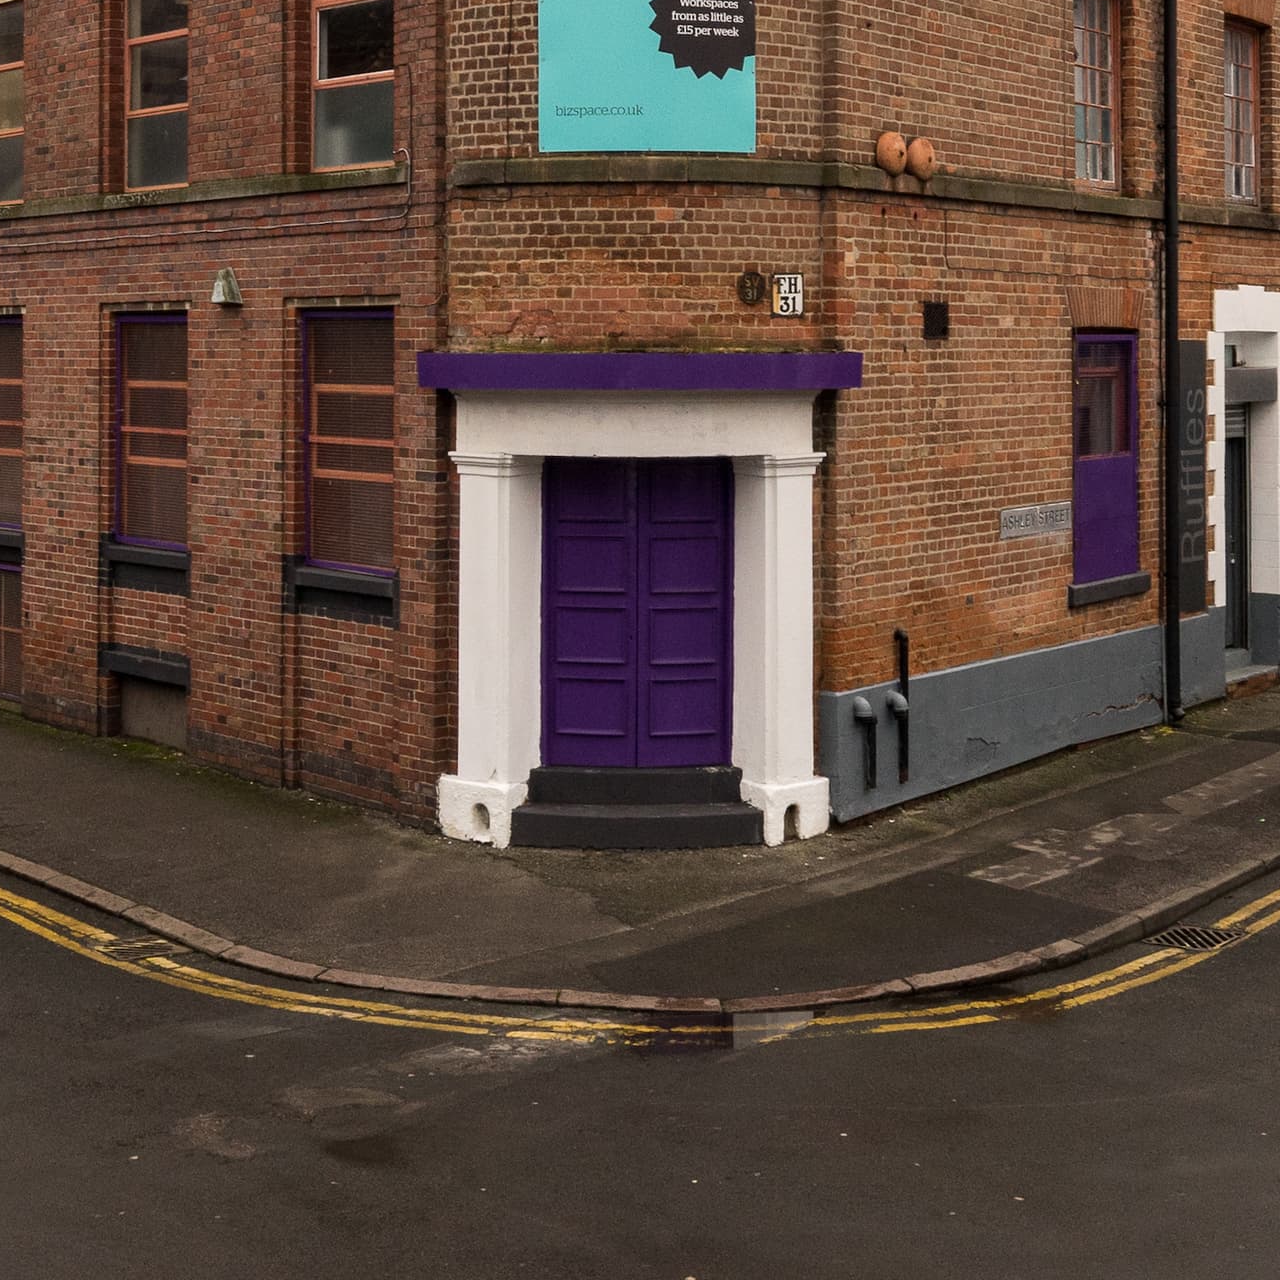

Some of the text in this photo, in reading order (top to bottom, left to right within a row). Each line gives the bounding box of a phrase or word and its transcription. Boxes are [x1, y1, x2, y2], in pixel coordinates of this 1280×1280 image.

[671, 11, 744, 23] from as little as
[677, 25, 739, 37] £15 per week
[555, 104, 644, 118] bizspace.co.uk
[780, 296, 796, 313] 31
[1002, 508, 1070, 530] ASHLEY STREET
